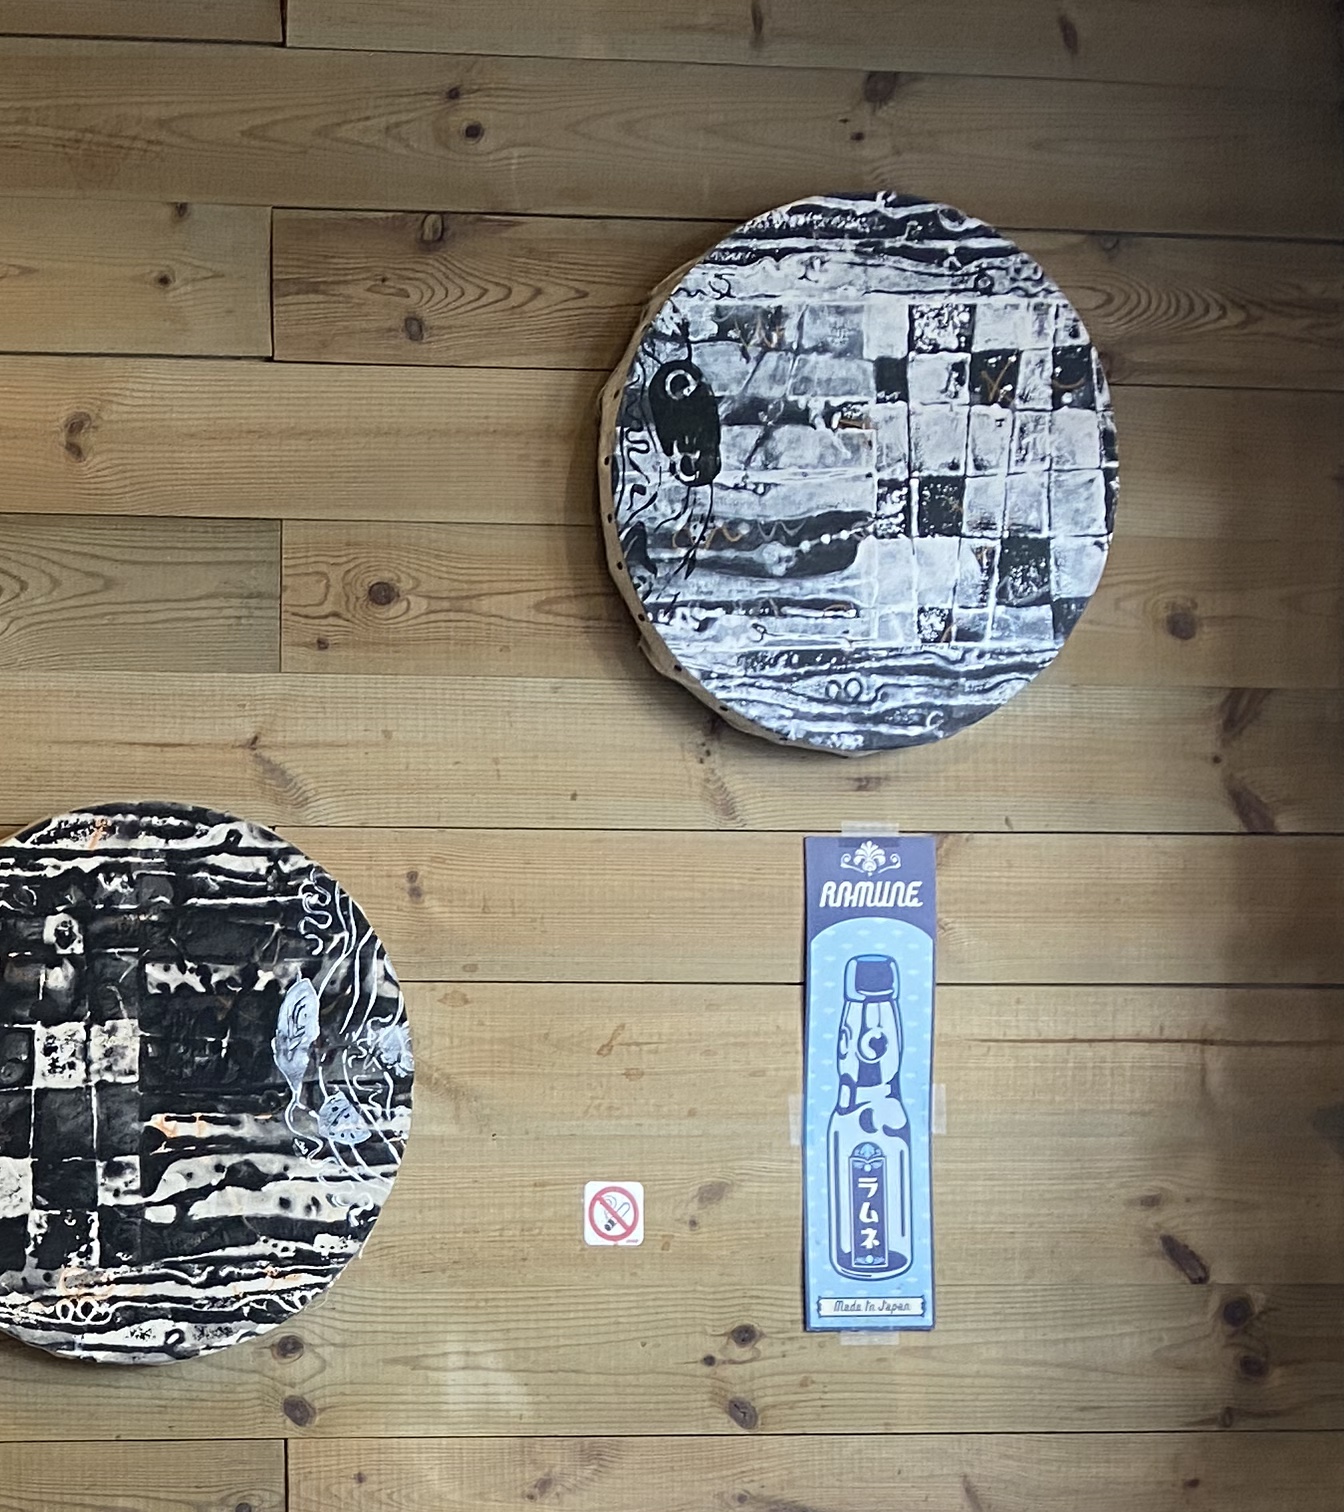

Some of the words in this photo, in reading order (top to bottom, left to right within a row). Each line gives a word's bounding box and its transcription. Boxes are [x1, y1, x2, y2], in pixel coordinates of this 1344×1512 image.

[819, 881, 923, 908] RAMUNE
[856, 1176, 880, 1249] ラムネ
[834, 1300, 861, 1312] Made
[878, 1299, 911, 1314] Japan
